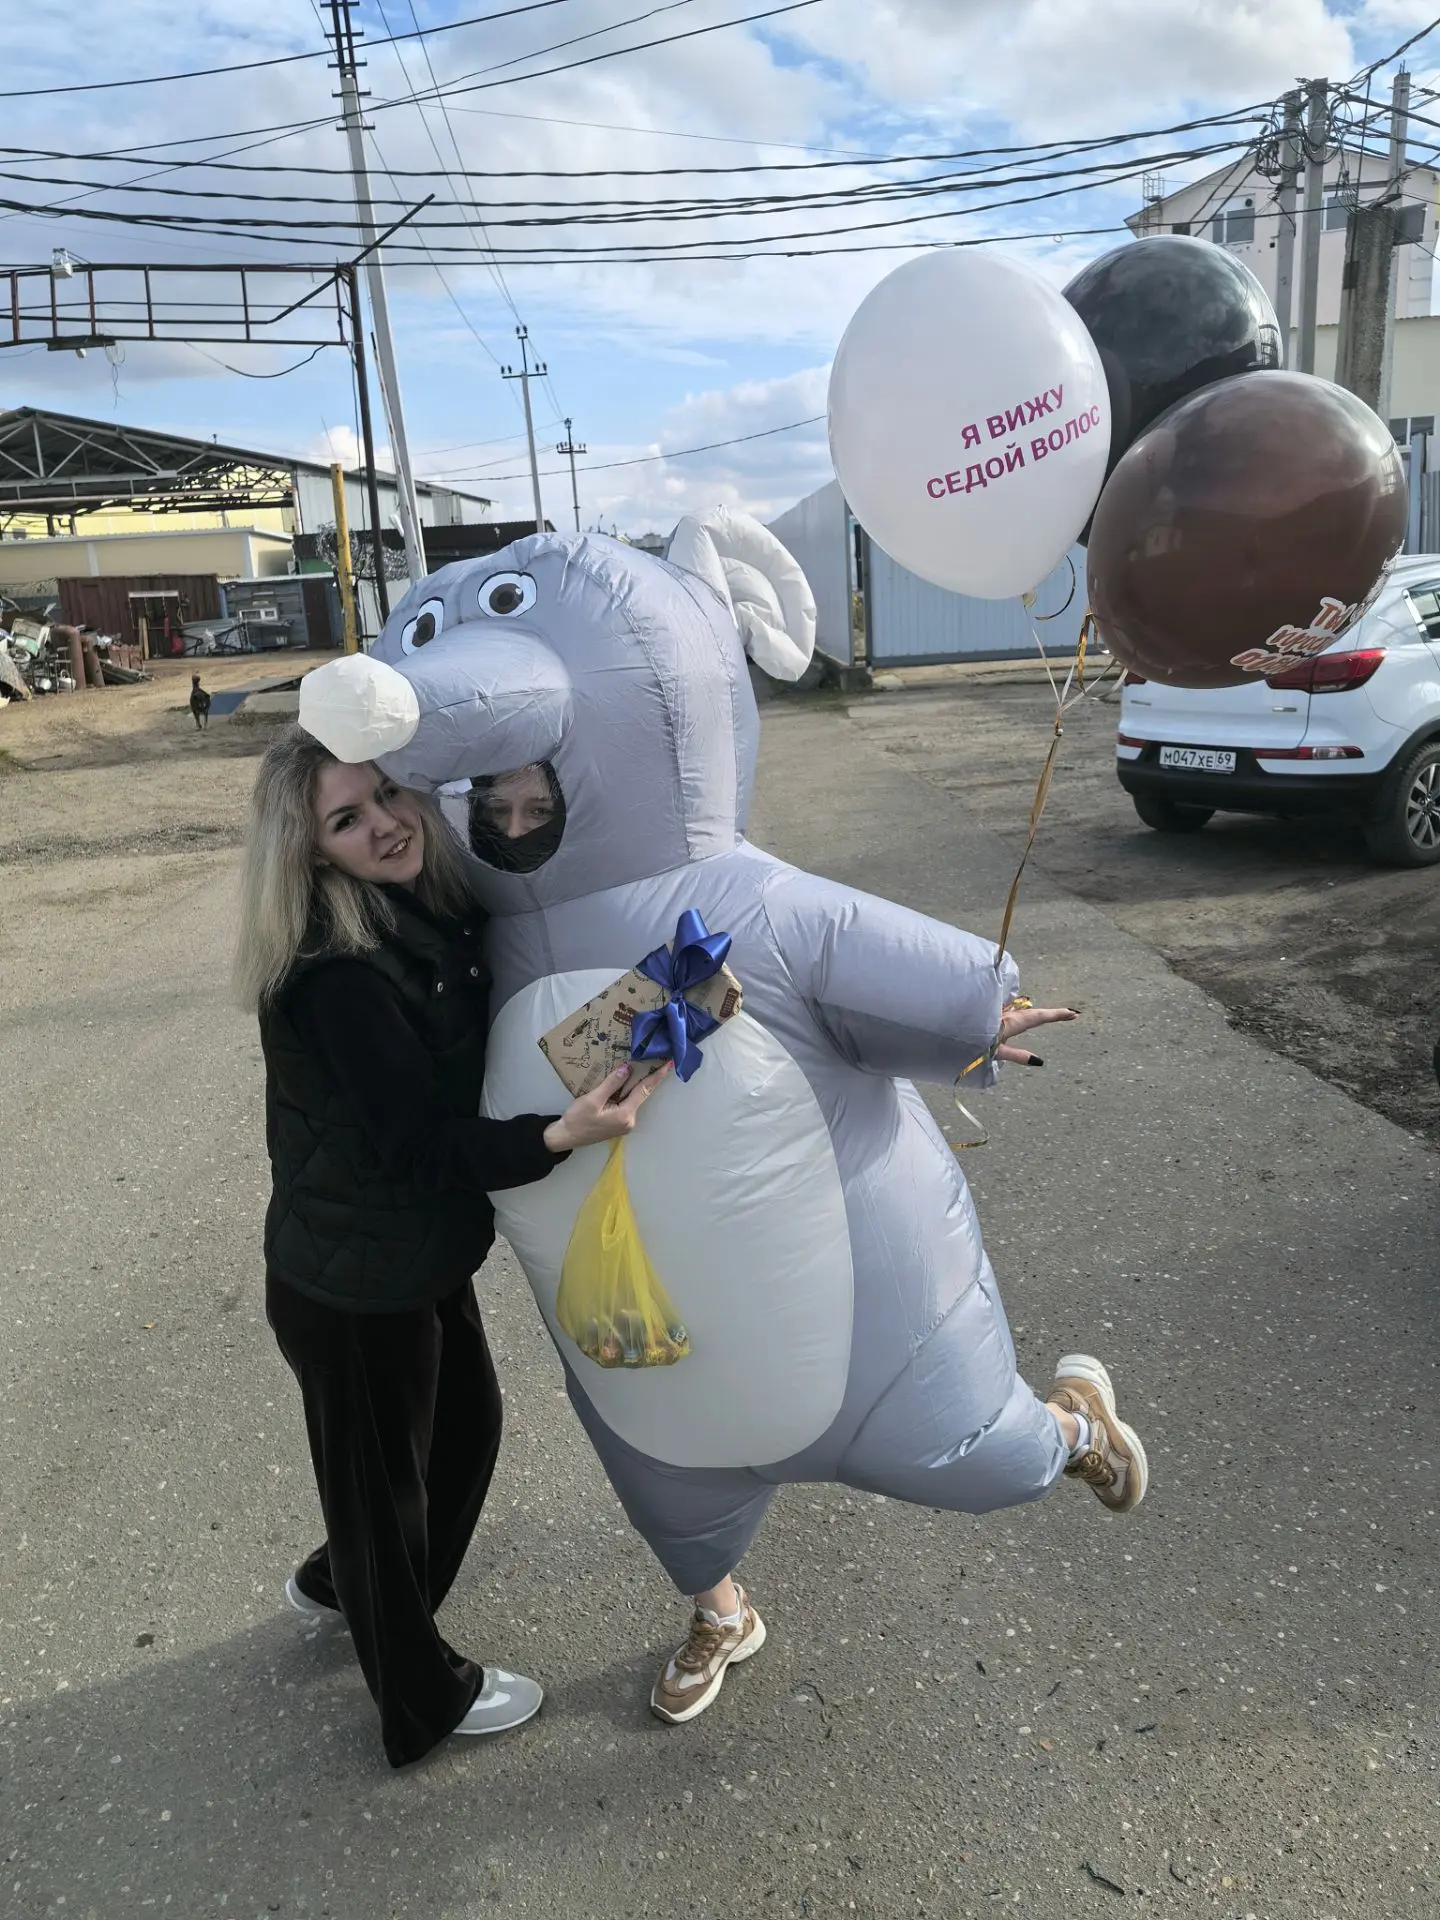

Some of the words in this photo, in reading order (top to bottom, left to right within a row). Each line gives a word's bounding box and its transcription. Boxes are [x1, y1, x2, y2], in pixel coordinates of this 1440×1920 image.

[926, 441, 1026, 499] СЕДОЙ
[1030, 404, 1101, 462] ВОЛОС
[961, 423, 982, 450] Я
[985, 383, 1064, 440] ВИЖУ
